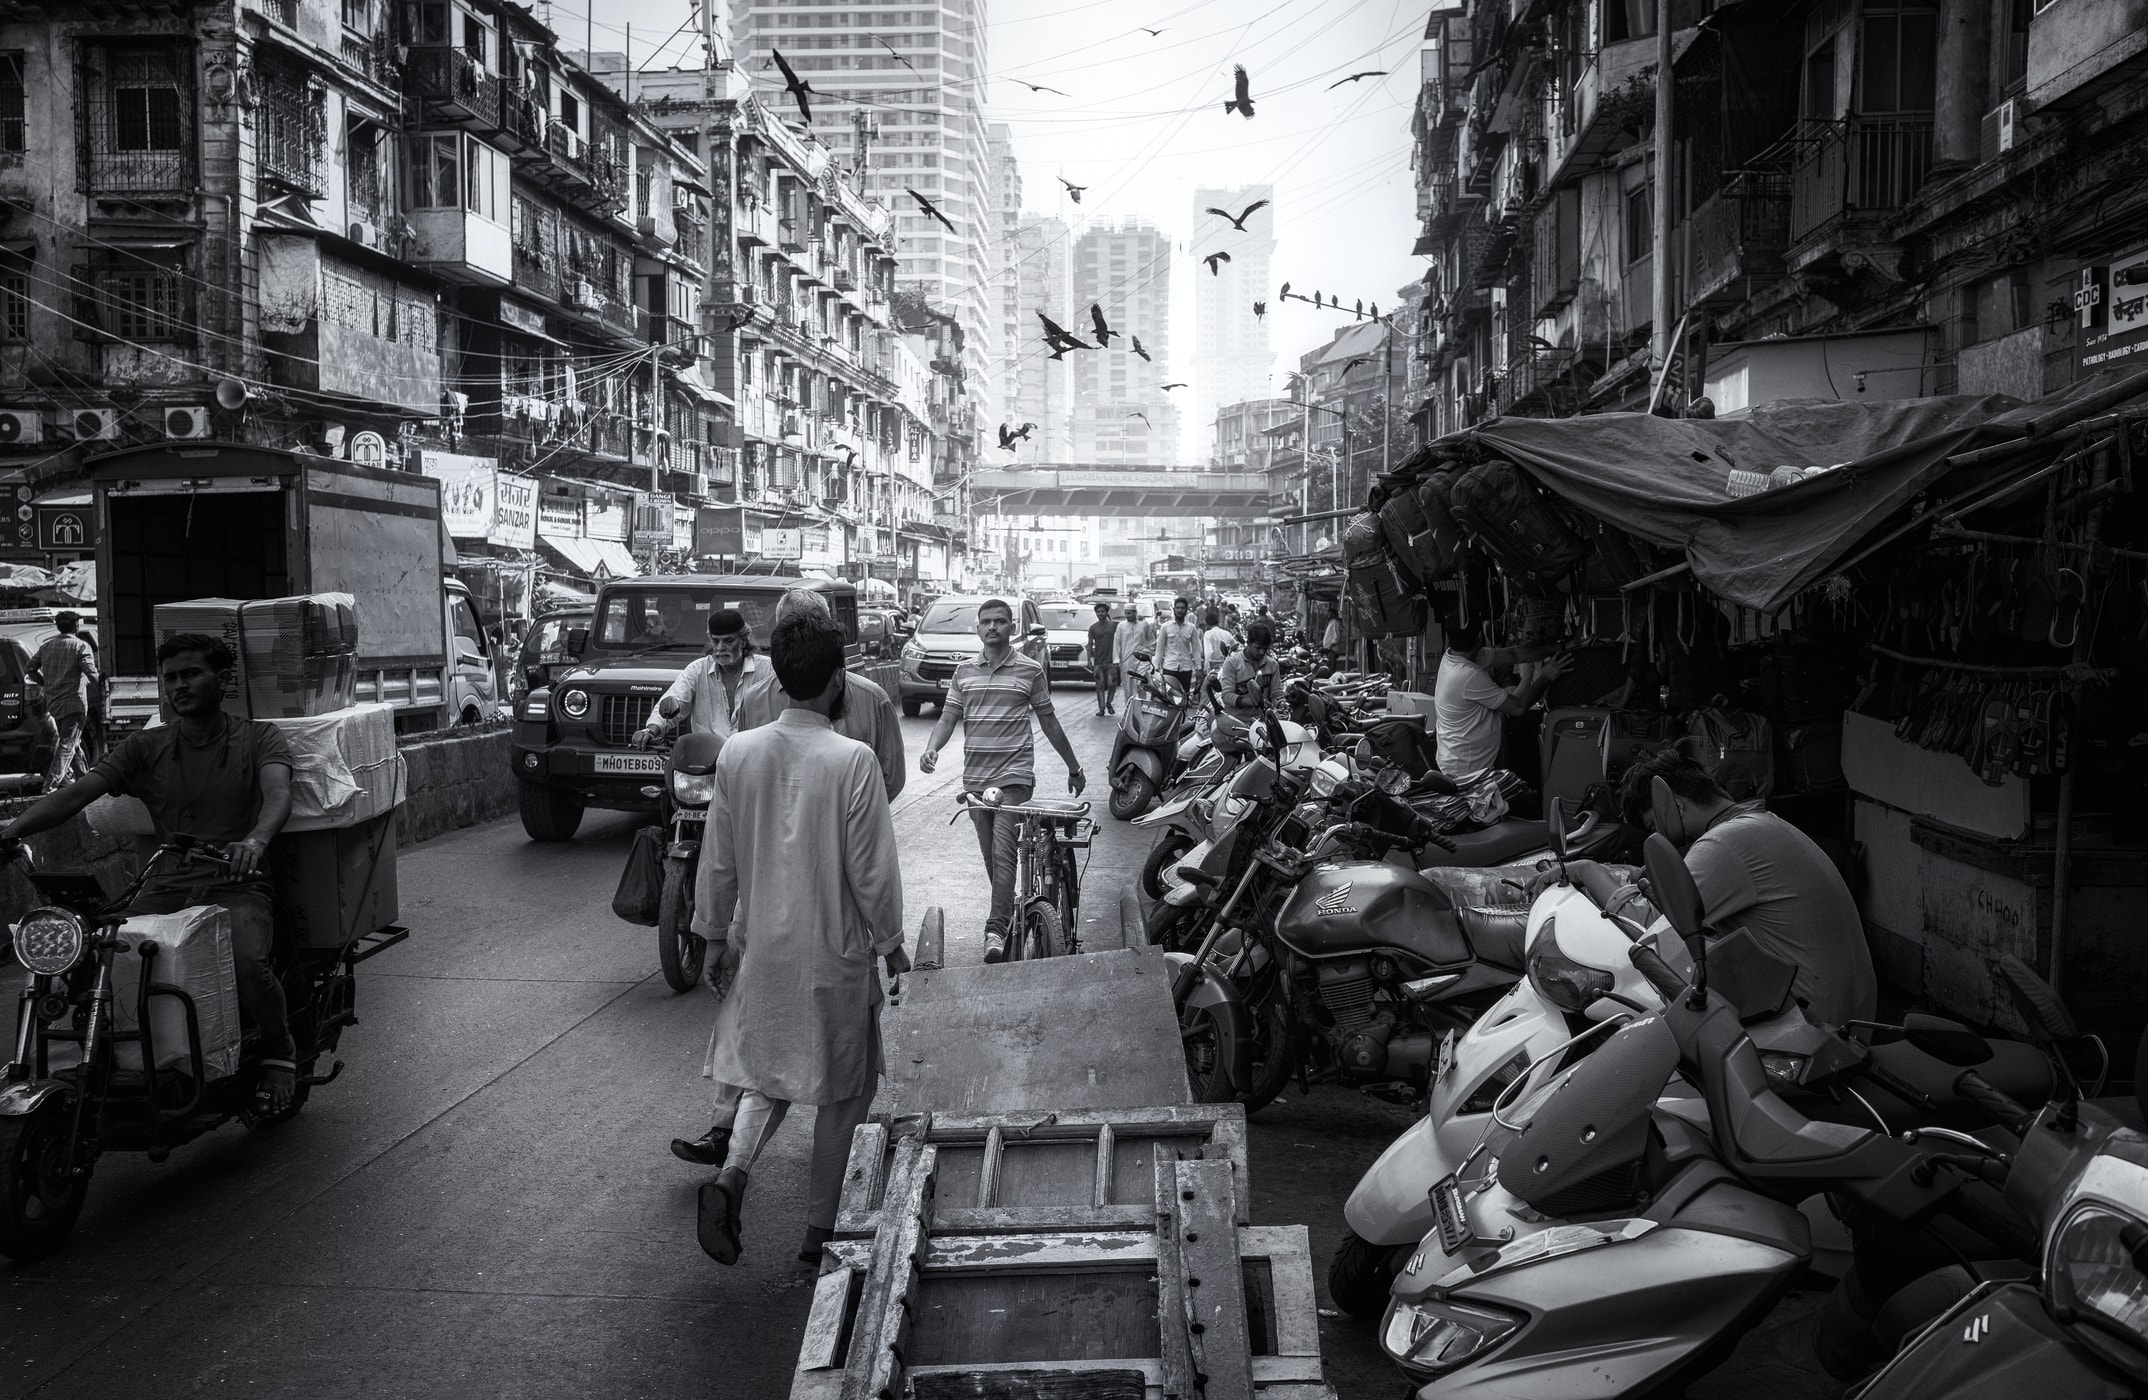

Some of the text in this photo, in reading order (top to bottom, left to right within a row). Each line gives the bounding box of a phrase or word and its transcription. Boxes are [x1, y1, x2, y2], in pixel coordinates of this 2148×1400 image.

[2075, 287, 2099, 309] CDC
[498, 507, 530, 530] SANZAR
[1317, 906, 1358, 917] HONDA
[1451, 1187, 1467, 1223] BURGMAN
